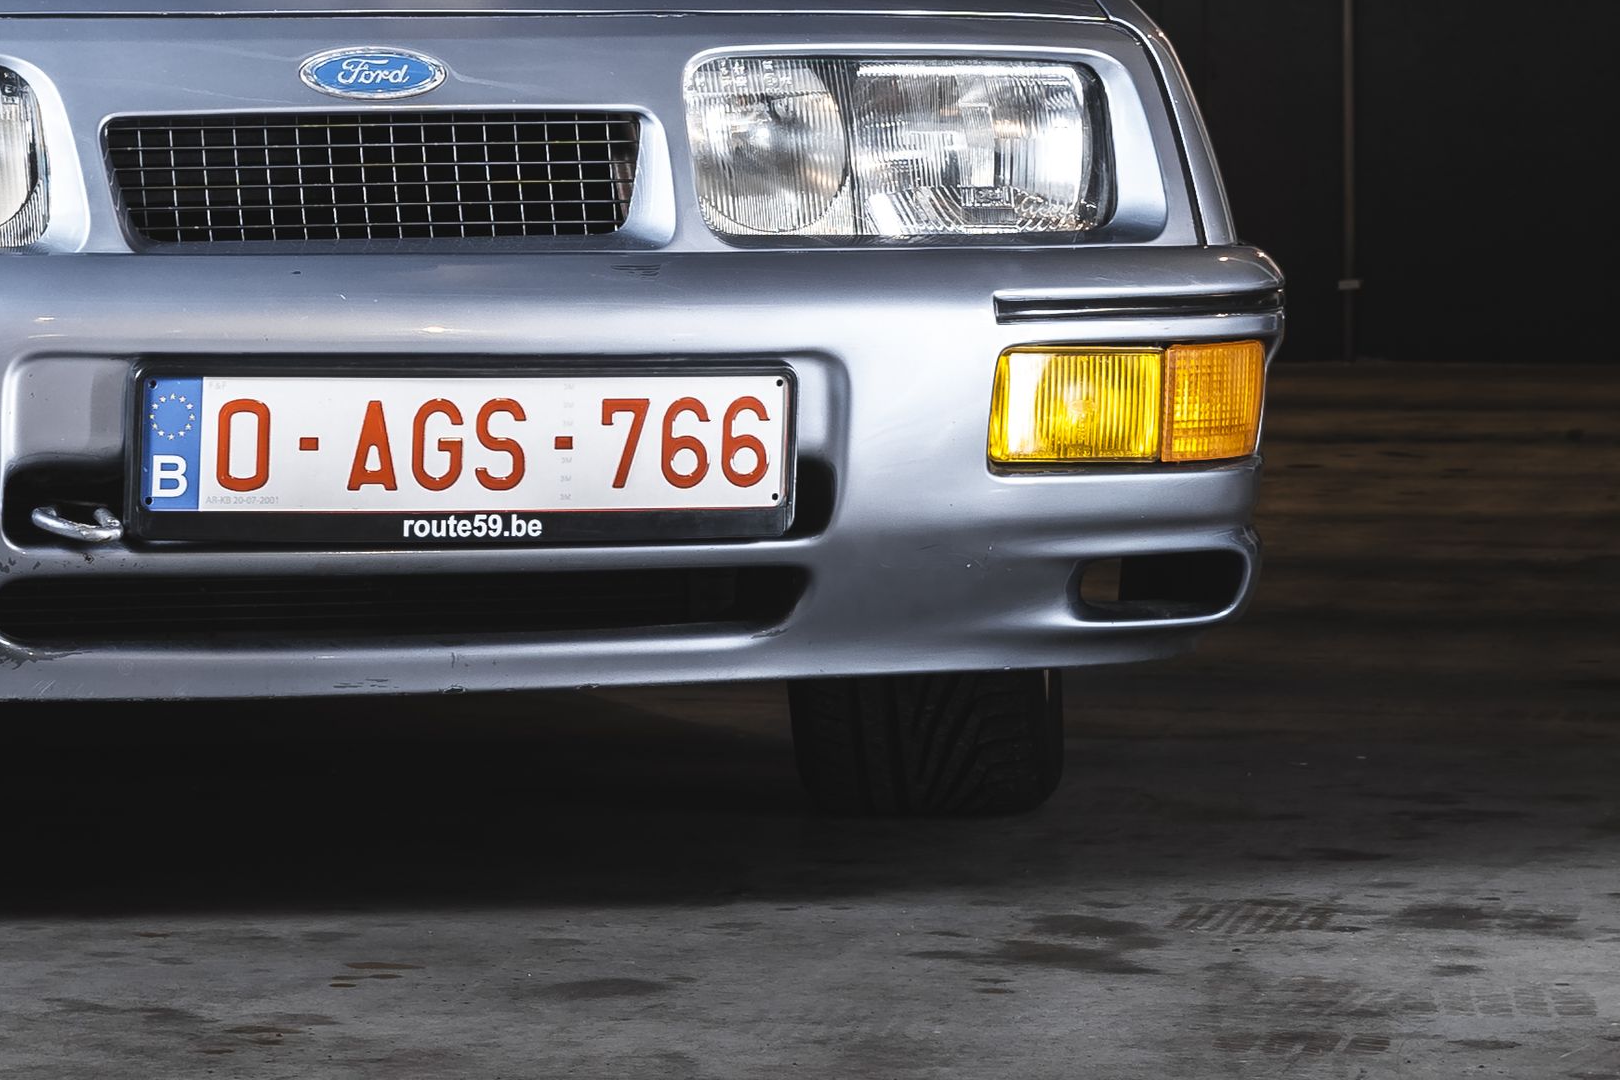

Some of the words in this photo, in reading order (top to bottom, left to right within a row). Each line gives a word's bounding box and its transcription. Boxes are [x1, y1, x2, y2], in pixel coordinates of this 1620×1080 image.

[337, 58, 410, 84] Ford
[152, 454, 188, 498] B
[233, 496, 279, 505] 20-07-2001
[403, 513, 543, 538] route59.be
